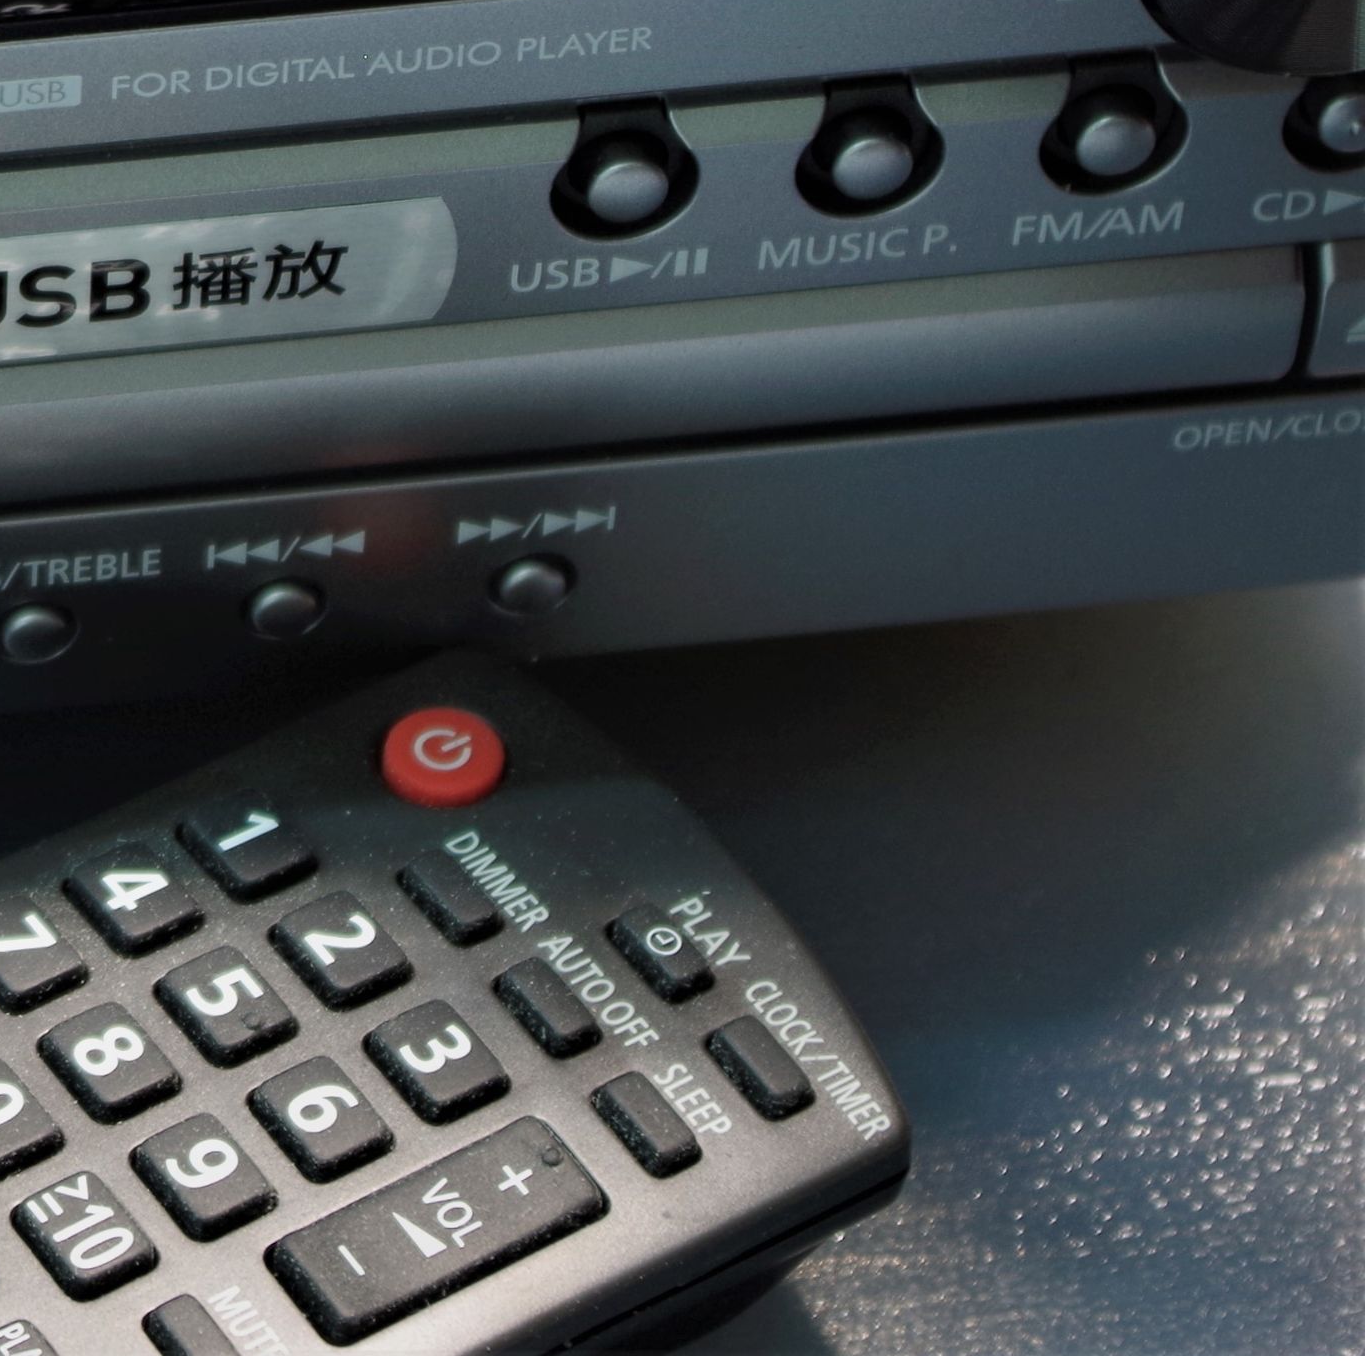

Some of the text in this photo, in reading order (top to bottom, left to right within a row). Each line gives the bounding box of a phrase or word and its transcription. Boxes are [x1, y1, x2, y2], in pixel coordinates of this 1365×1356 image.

[111, 71, 190, 100] FOR
[205, 56, 355, 91] DIGITAL
[366, 40, 503, 76] AUDIO
[515, 26, 654, 60] PLAYER
[758, 225, 958, 271] MUSIC P.
[1011, 201, 1186, 246] FM/AM
[172, 238, 350, 311] 播放
[1174, 409, 1365, 452] OPEN/CLO
[218, 812, 279, 853] 1
[101, 869, 169, 912] 4
[445, 830, 550, 934] DIMMER
[304, 914, 378, 967] 2
[671, 895, 752, 969] PLAY
[186, 965, 265, 1017] 5
[537, 936, 660, 1047] AUTO OFF
[73, 1025, 145, 1077] 8
[399, 1023, 472, 1075] 3
[745, 981, 891, 1141] CLOCK/TIMER
[287, 1084, 361, 1133] 6
[655, 1061, 733, 1138] SLEEP
[166, 1138, 240, 1189] 9
[422, 1177, 484, 1249] VOL
